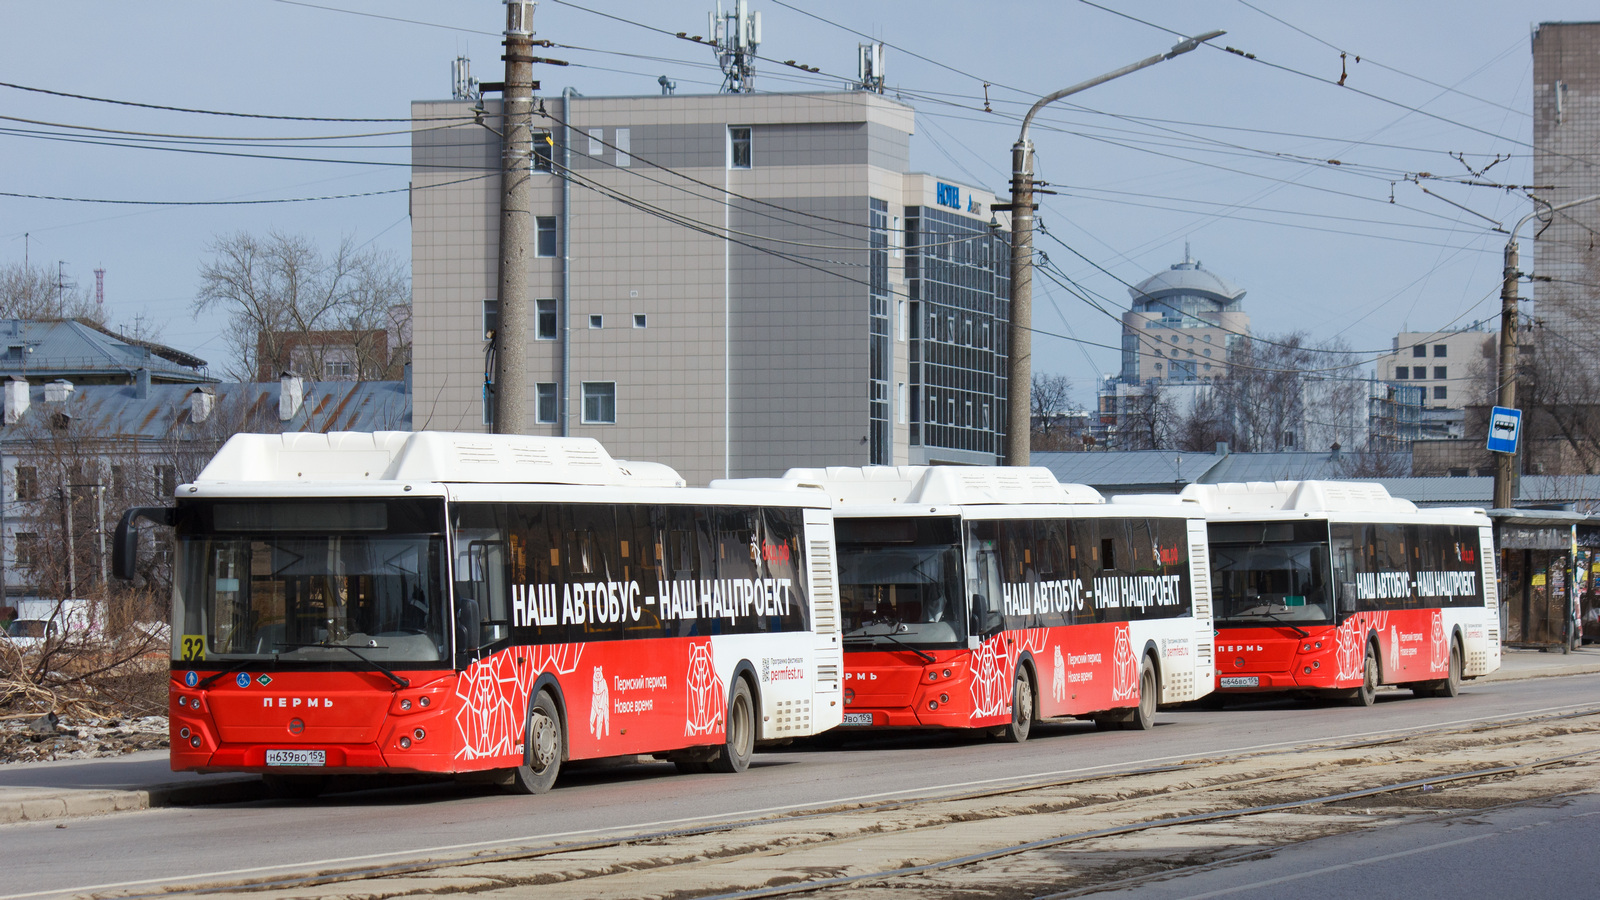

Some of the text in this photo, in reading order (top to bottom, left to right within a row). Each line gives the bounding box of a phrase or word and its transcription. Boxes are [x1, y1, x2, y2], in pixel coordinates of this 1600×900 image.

[937, 181, 960, 209] HOTEL
[1002, 582, 1031, 616] НАШ
[1033, 578, 1084, 615] АВТОБУС
[1093, 577, 1121, 610] НАШ
[1121, 575, 1180, 614] НАЦПРОЕКТ
[1356, 572, 1376, 600] НАШ
[1376, 571, 1411, 599] АВТОБУС
[1416, 571, 1435, 597] НАШ
[1434, 571, 1476, 602] НАЦПРОЕКТ
[512, 583, 558, 627] НАШ
[562, 580, 641, 625] АВТОБУС
[658, 580, 698, 620] НАШ
[700, 578, 792, 626] НАЦПРОЕКТ
[183, 637, 204, 660] 32
[1218, 645, 1264, 653] ПЕРМЬ
[614, 674, 668, 695] Пермский период
[770, 665, 804, 685] permfest.ru
[263, 697, 333, 708] ПЕРМЬ
[614, 698, 653, 716] Новое время
